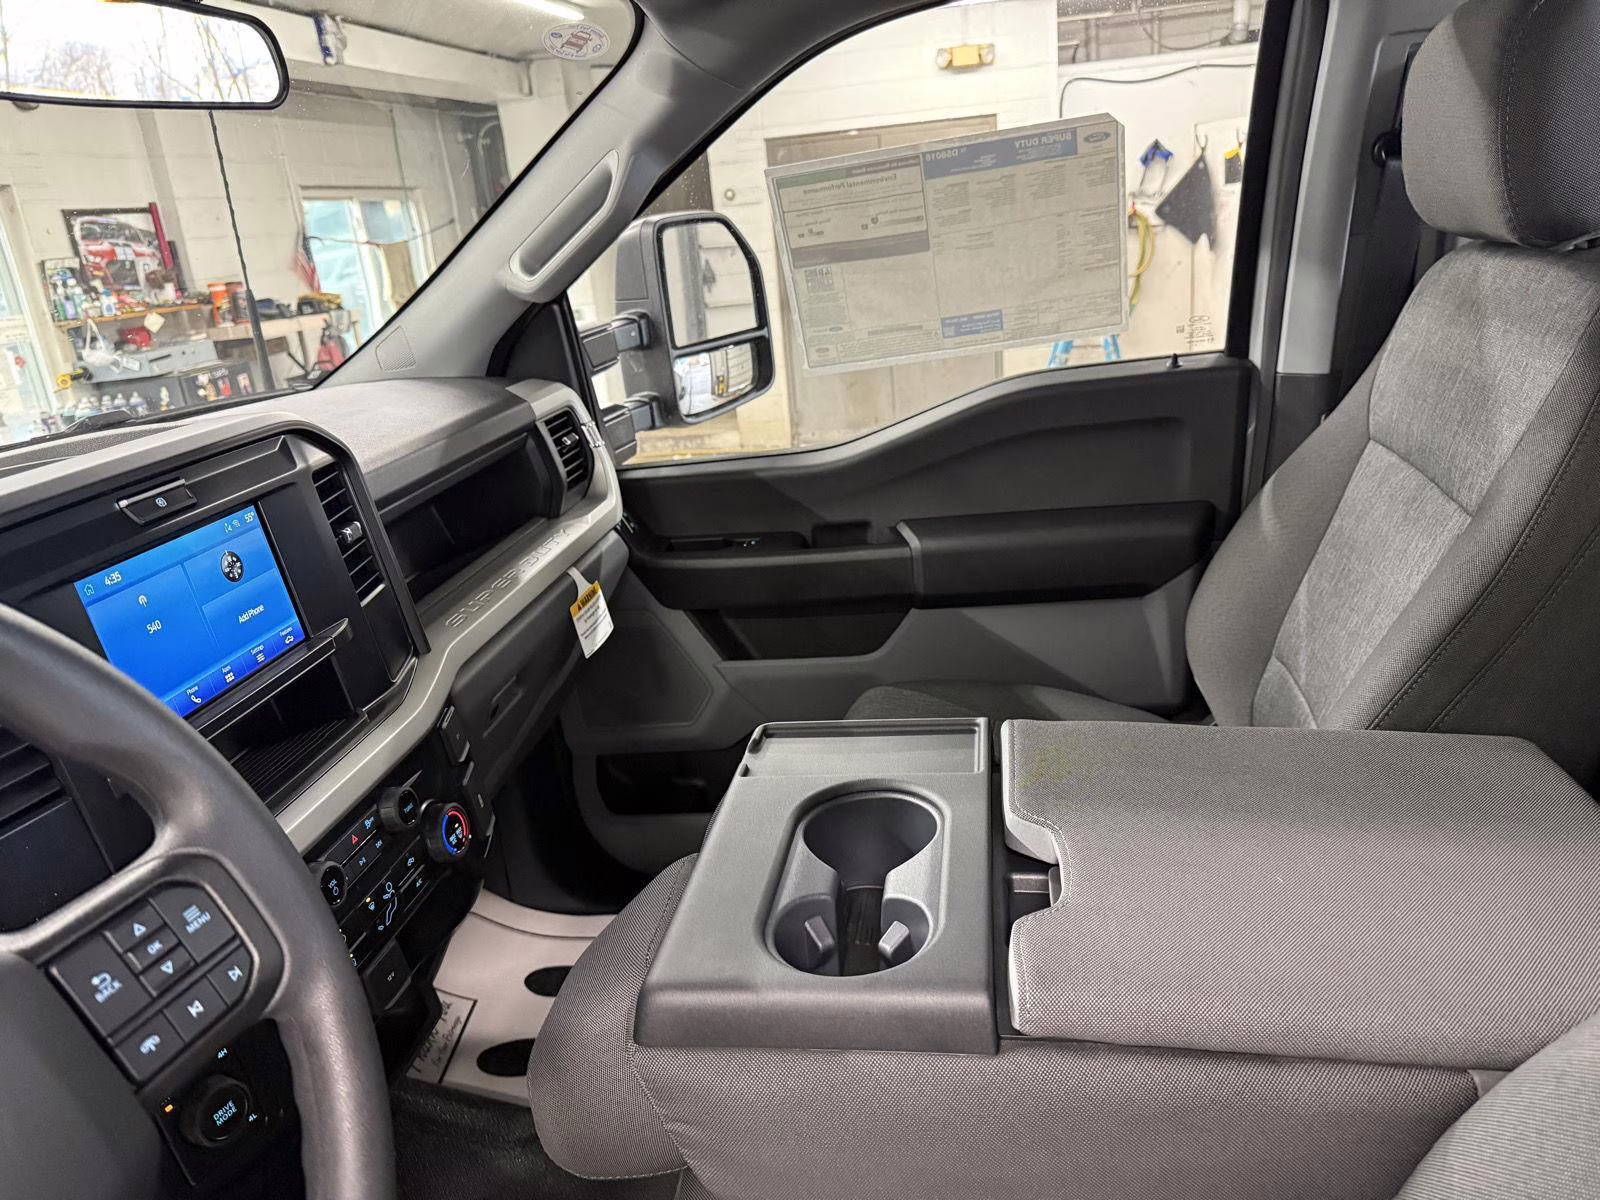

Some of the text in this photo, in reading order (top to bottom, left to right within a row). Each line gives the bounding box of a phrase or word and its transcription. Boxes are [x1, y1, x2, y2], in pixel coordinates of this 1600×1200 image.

[104, 571, 122, 586] 4:35
[445, 528, 570, 628] SUPER DUTY
[238, 604, 265, 624] Add Phone
[146, 619, 162, 634] 540
[185, 911, 211, 934] MENU
[147, 939, 163, 955] OK
[94, 979, 123, 1003] BACK
[217, 1047, 228, 1059] 4H
[213, 1099, 235, 1121] DRIVE
[215, 1105, 238, 1127] MODE
[248, 1113, 258, 1122] 4L
